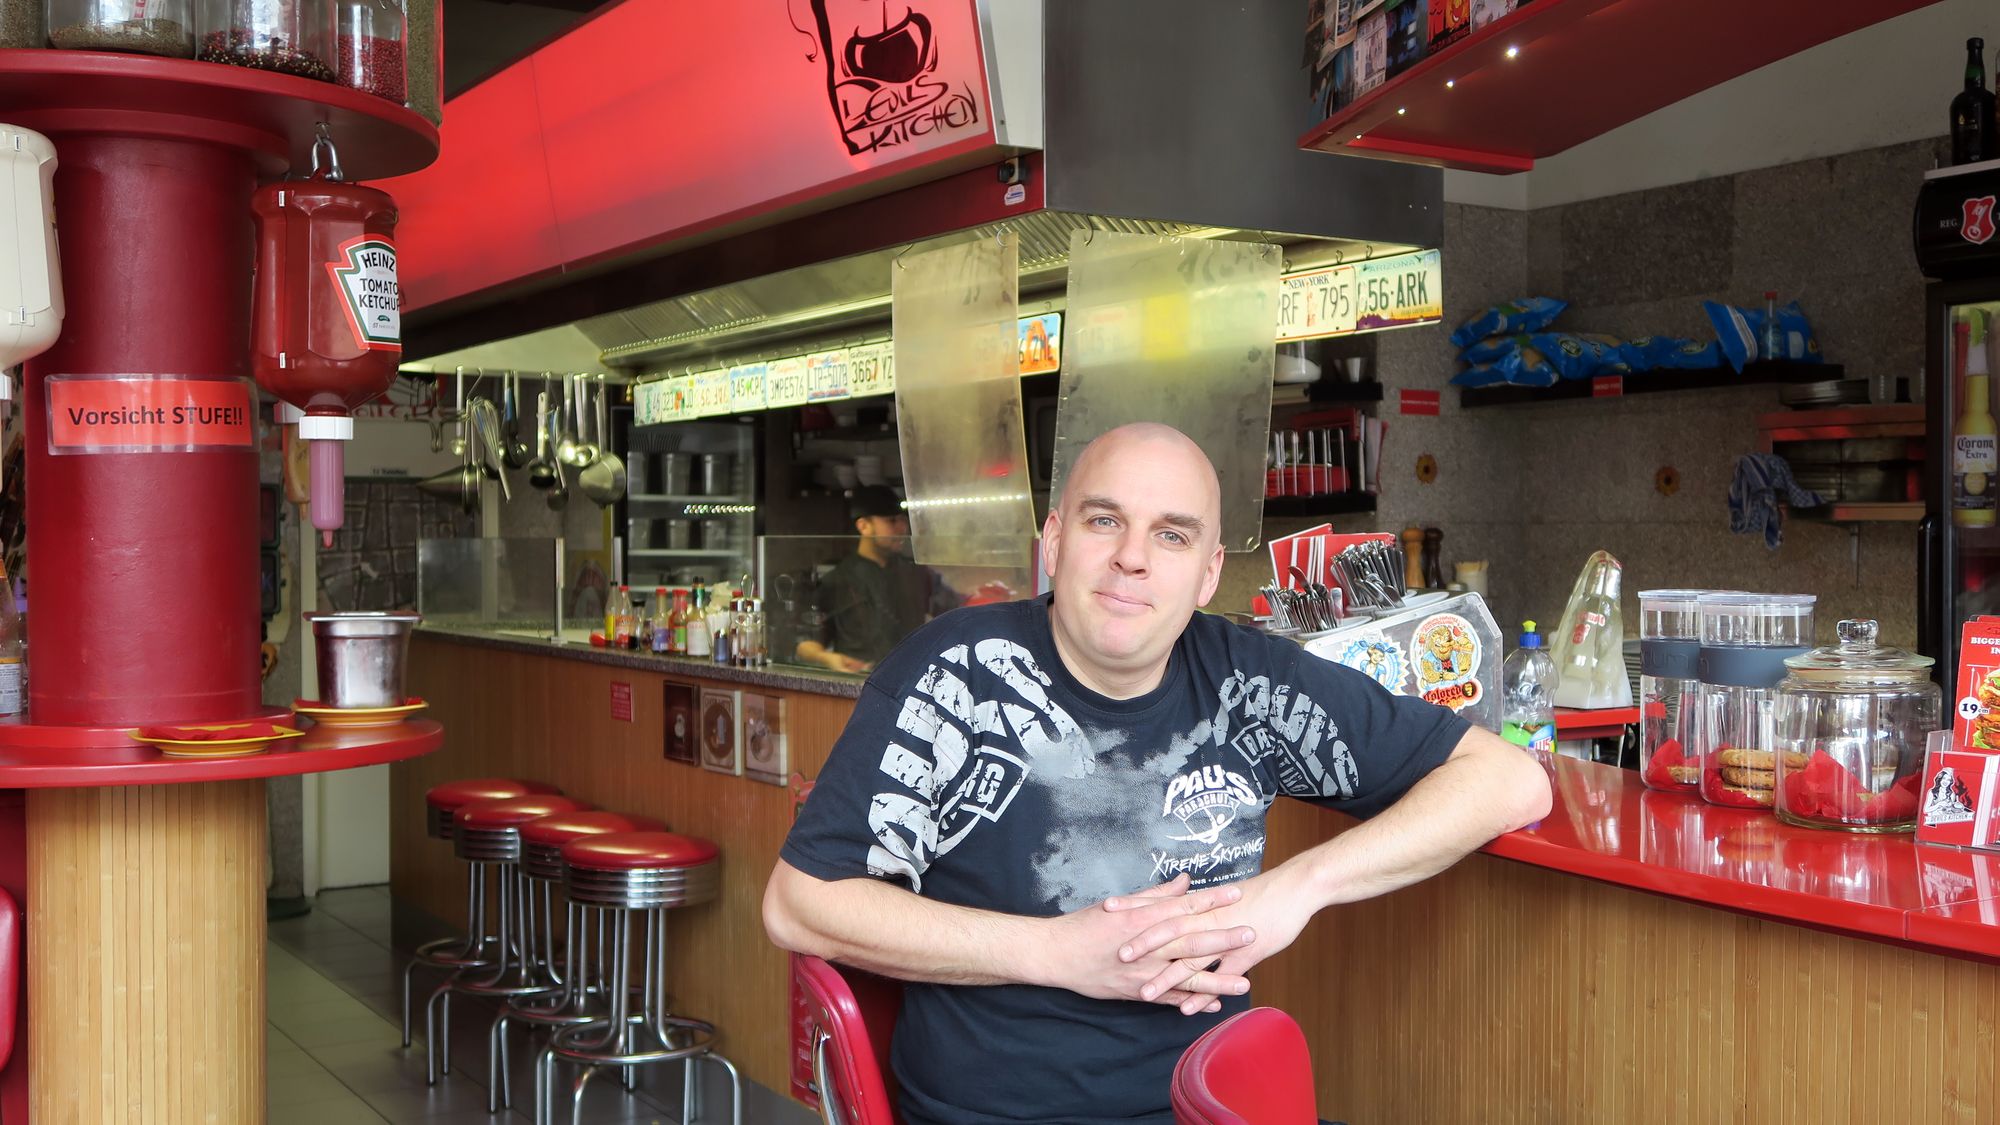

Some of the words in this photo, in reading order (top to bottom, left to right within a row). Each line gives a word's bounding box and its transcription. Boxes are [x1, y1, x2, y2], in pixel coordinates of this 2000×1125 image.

[868, 81, 979, 154] KITCHEN
[361, 252, 396, 272] HEINZ
[360, 278, 398, 294] TOMATO
[1287, 278, 1306, 290] NEW
[1308, 273, 1330, 286] YORK
[1276, 291, 1301, 327] RF
[1319, 284, 1350, 321] 795
[851, 358, 878, 384] 3667
[68, 405, 165, 426] Vorsicht
[172, 406, 243, 426] STUFE!!
[1957, 437, 1994, 451] Corona
[1966, 449, 1988, 459] Extra
[1961, 703, 1978, 713] 19
[1149, 850, 1210, 882] XTREME
